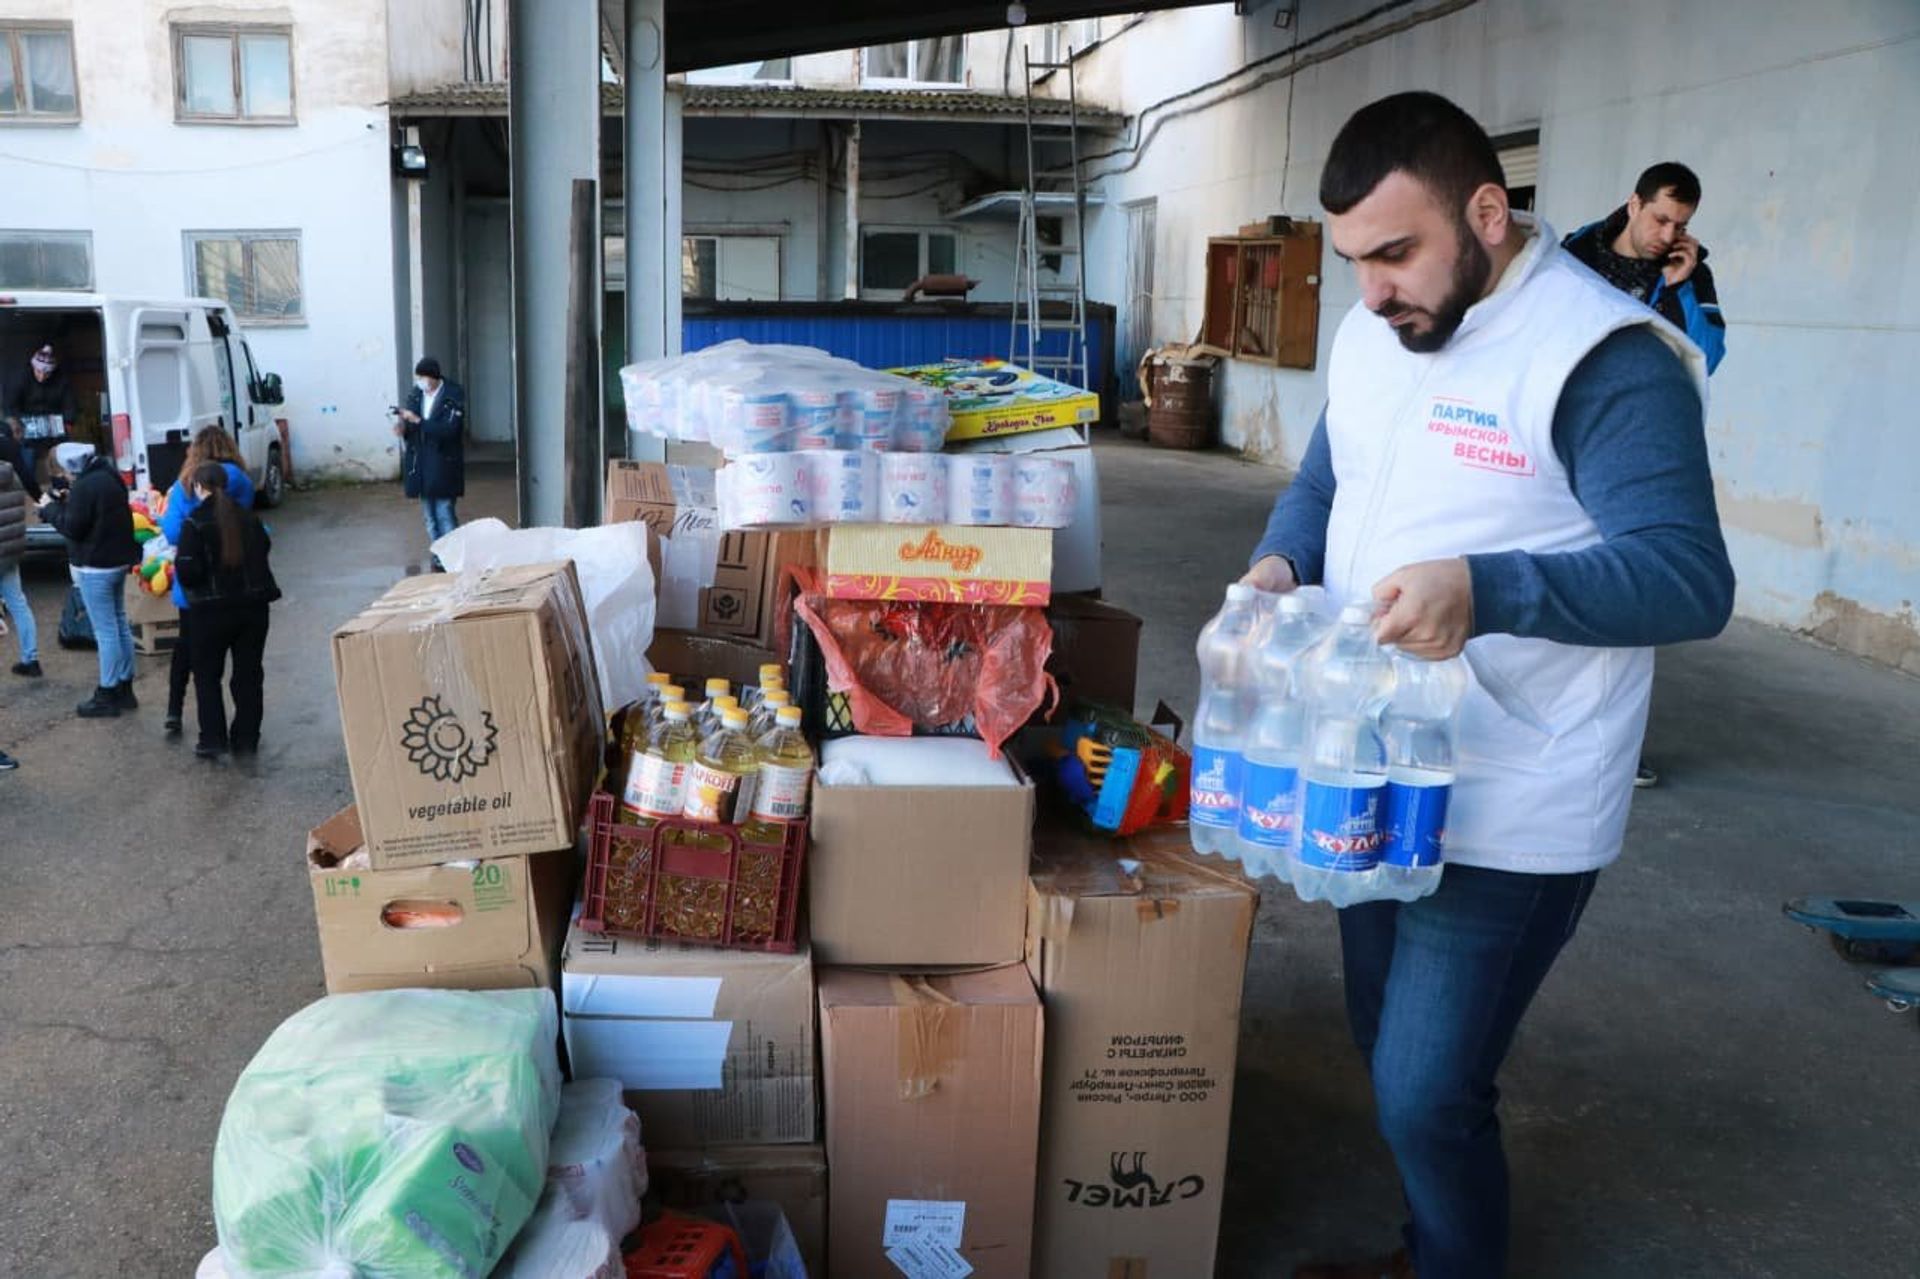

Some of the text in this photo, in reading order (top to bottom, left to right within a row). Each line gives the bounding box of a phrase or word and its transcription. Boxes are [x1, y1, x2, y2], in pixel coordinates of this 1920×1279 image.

[1432, 403, 1498, 427] ПАРТИЯ
[1428, 420, 1509, 445] КРЫМСКОЙ
[1453, 442, 1526, 468] ВЕСНЫ
[408, 792, 512, 821] vegetable oil
[472, 864, 501, 886] 20
[1111, 1034, 1184, 1046] ФИЛЬТРОМ
[1106, 1047, 1187, 1059] СИГАРЕТЫ С
[1085, 1069, 1098, 1078] 71
[1069, 1080, 1174, 1091] Санкт-Петербург
[1077, 1093, 1122, 1104] Россия
[1179, 1091, 1207, 1101] ООО
[1062, 1174, 1205, 1208] CAMEL
